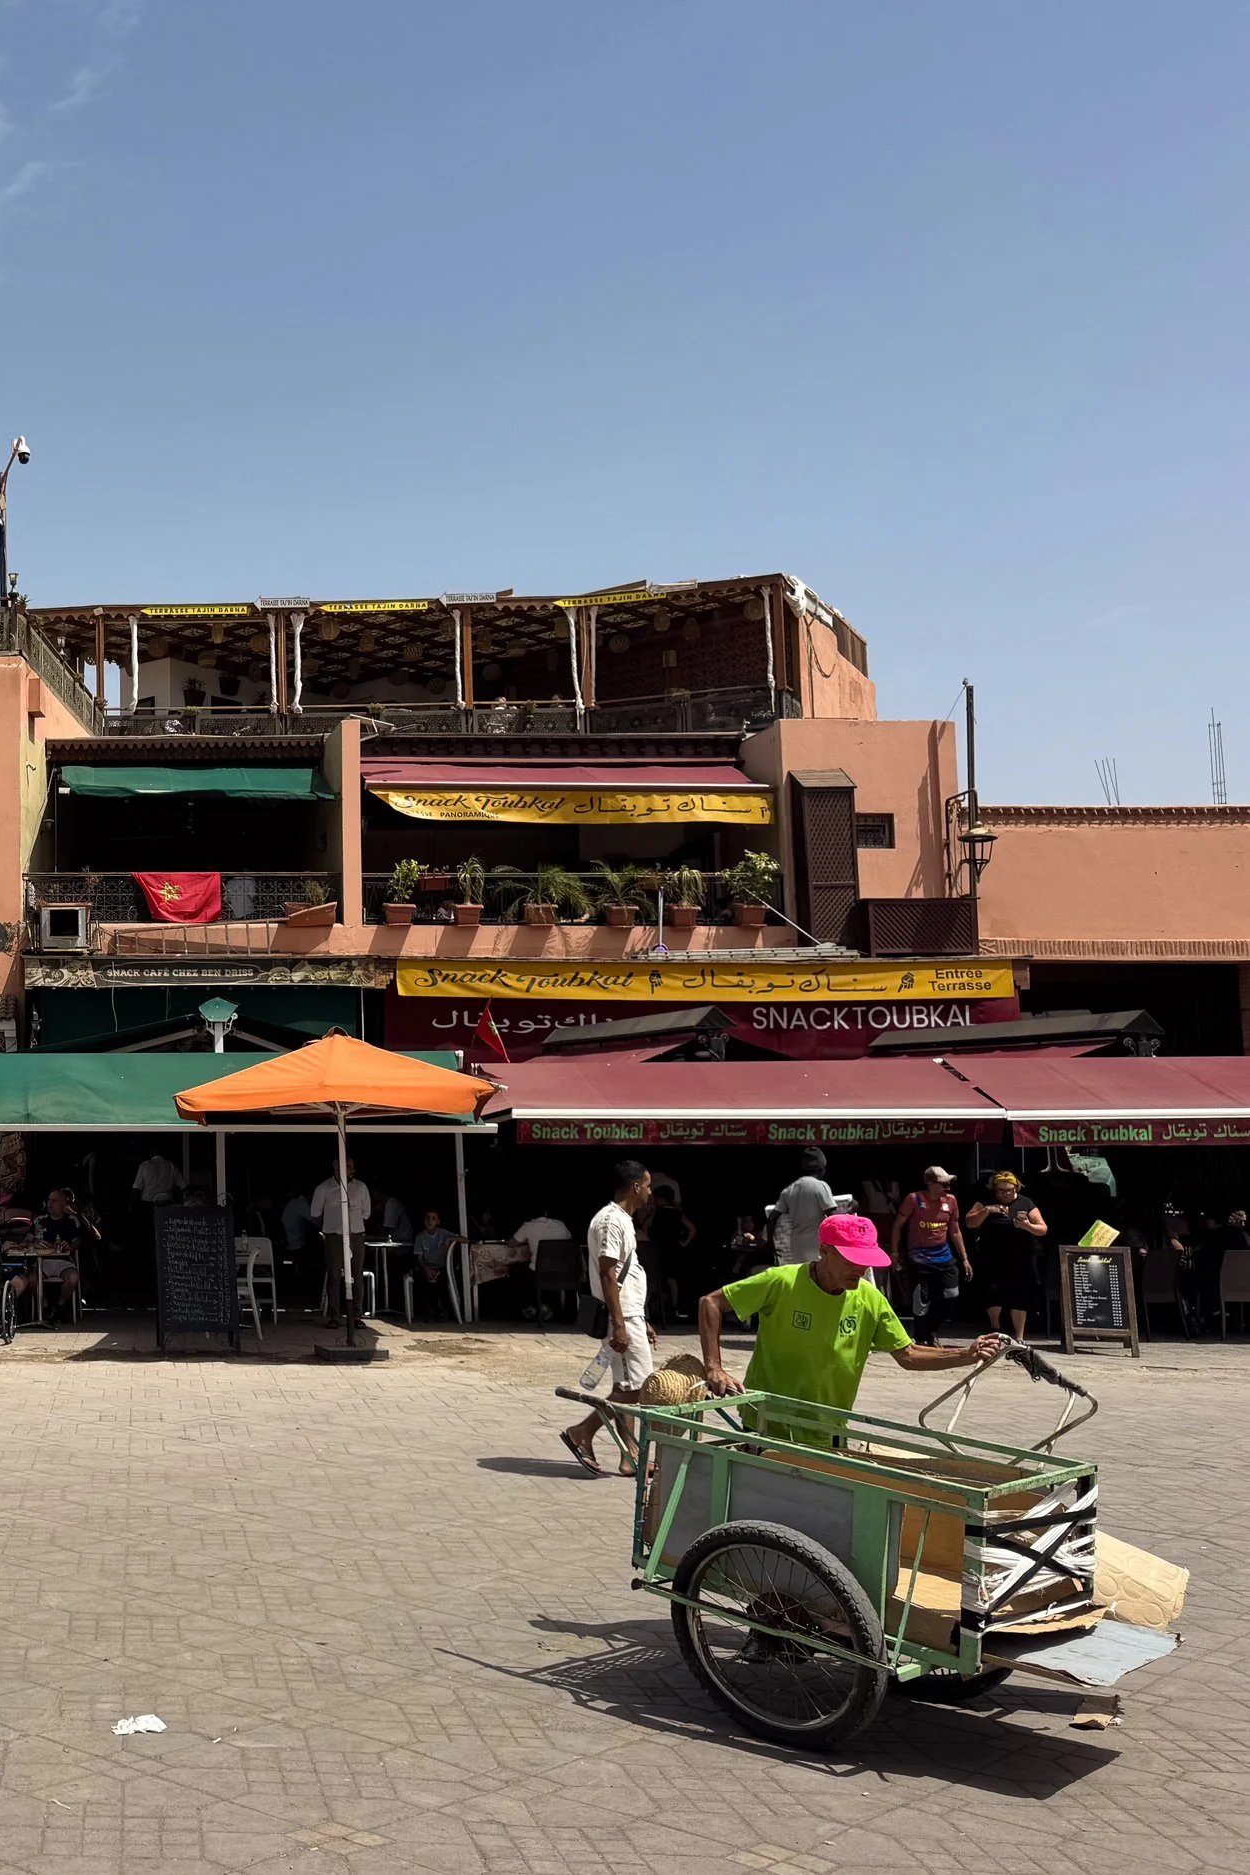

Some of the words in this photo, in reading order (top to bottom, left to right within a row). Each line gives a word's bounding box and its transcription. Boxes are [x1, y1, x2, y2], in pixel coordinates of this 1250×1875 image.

[475, 796, 566, 812] Toubkal
[107, 968, 141, 977] SNACK
[143, 967, 170, 977] CAFÉ
[172, 968, 199, 977] CHEZ
[201, 968, 223, 977] BEN
[224, 968, 254, 977] DRISS
[935, 968, 983, 979] Entrée
[414, 968, 513, 989] Snack
[516, 970, 635, 993] Toubkal
[682, 968, 795, 994] توبقال
[798, 968, 888, 993] سناك
[928, 980, 992, 991] Terrasse
[532, 1123, 579, 1139] Snack
[584, 1123, 644, 1139] Toubkal
[768, 1123, 816, 1140] Snack
[820, 1124, 879, 1140] Toubkal
[1038, 1125, 1086, 1142] Snack
[1091, 1124, 1153, 1142] Toubkal
